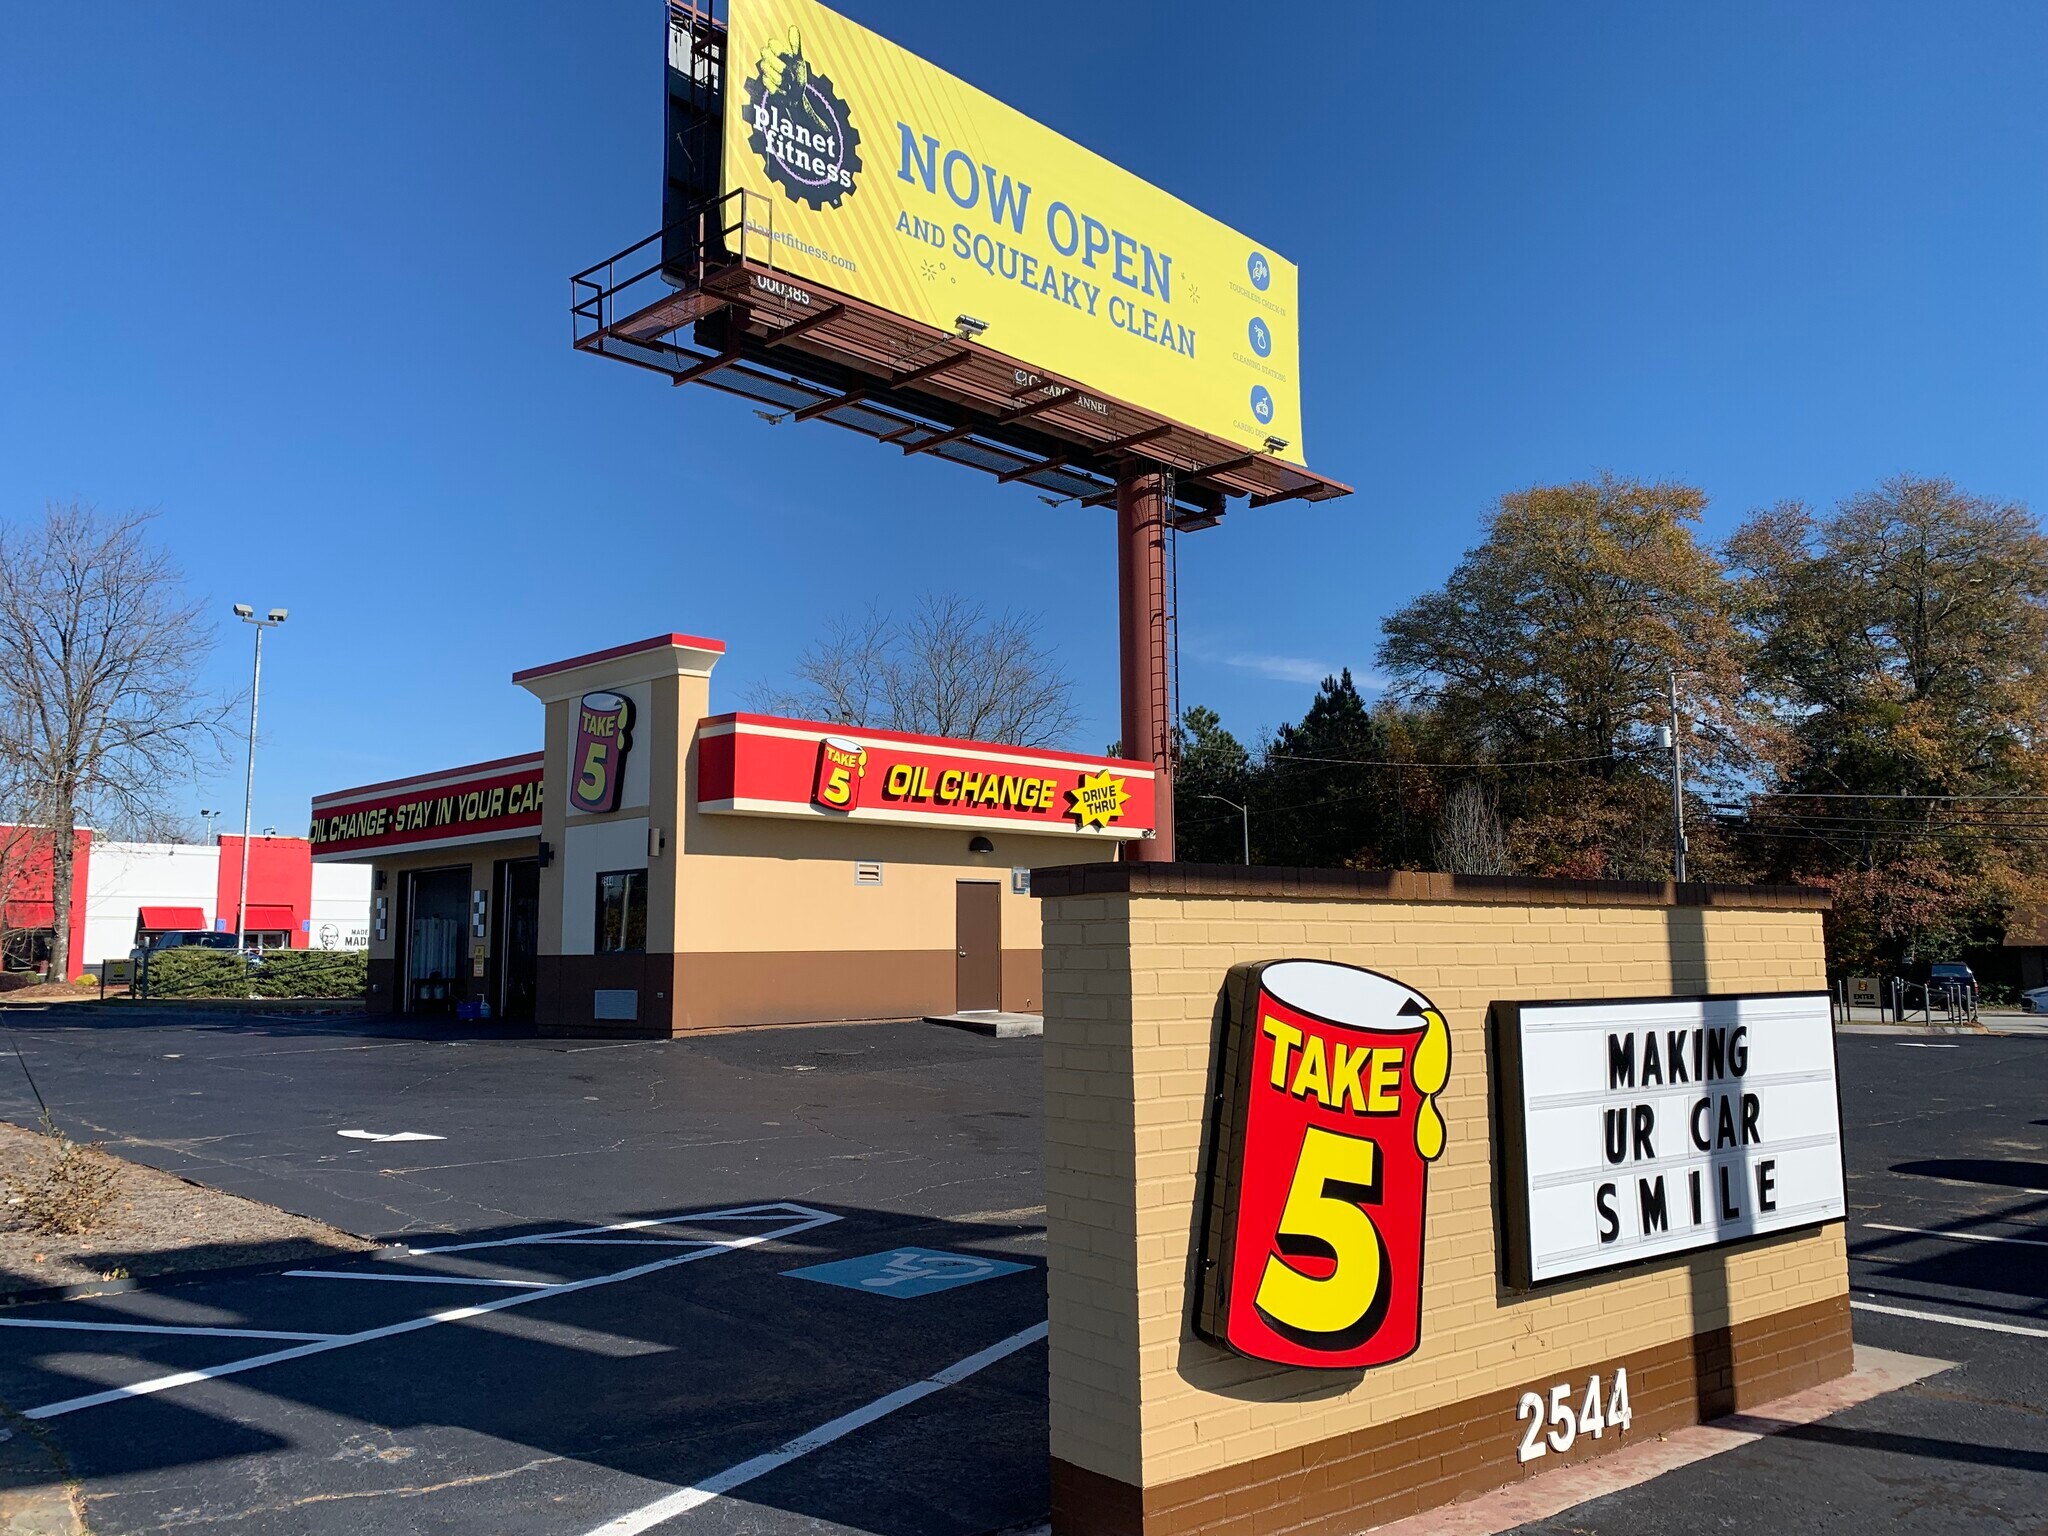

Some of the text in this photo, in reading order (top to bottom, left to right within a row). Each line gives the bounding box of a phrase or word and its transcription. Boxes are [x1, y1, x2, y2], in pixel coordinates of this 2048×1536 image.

[753, 103, 836, 158] planet
[764, 129, 852, 188] fitness
[896, 120, 1172, 304] NOW OPEN
[744, 218, 857, 272] planetfitness.com
[895, 210, 1196, 359] AND SQUEAKY CLEAN
[1229, 281, 1262, 304] TOUCHLESS
[1232, 351, 1287, 383] CLEANING STATIONS
[582, 711, 616, 737] TAKE
[577, 742, 607, 803] 5
[823, 766, 851, 804] 5
[826, 747, 857, 769] TAKE
[887, 764, 1058, 809] OIL CHANGE
[1082, 784, 1118, 804] DRIVE
[1086, 797, 1117, 816] THRU
[308, 818, 328, 844] OIL
[329, 807, 387, 842] CHANGE
[395, 799, 434, 832] STAY
[435, 796, 454, 826] IN
[458, 786, 504, 822] YOUR
[345, 937, 369, 946] MAD
[1261, 1014, 1404, 1116] TAKE
[1607, 1025, 1749, 1090] MAKING
[1604, 1092, 1762, 1165] UR CAR
[1595, 1159, 1779, 1244] SMILE
[1254, 1126, 1386, 1346] 5
[1515, 1367, 1633, 1464] 2544
